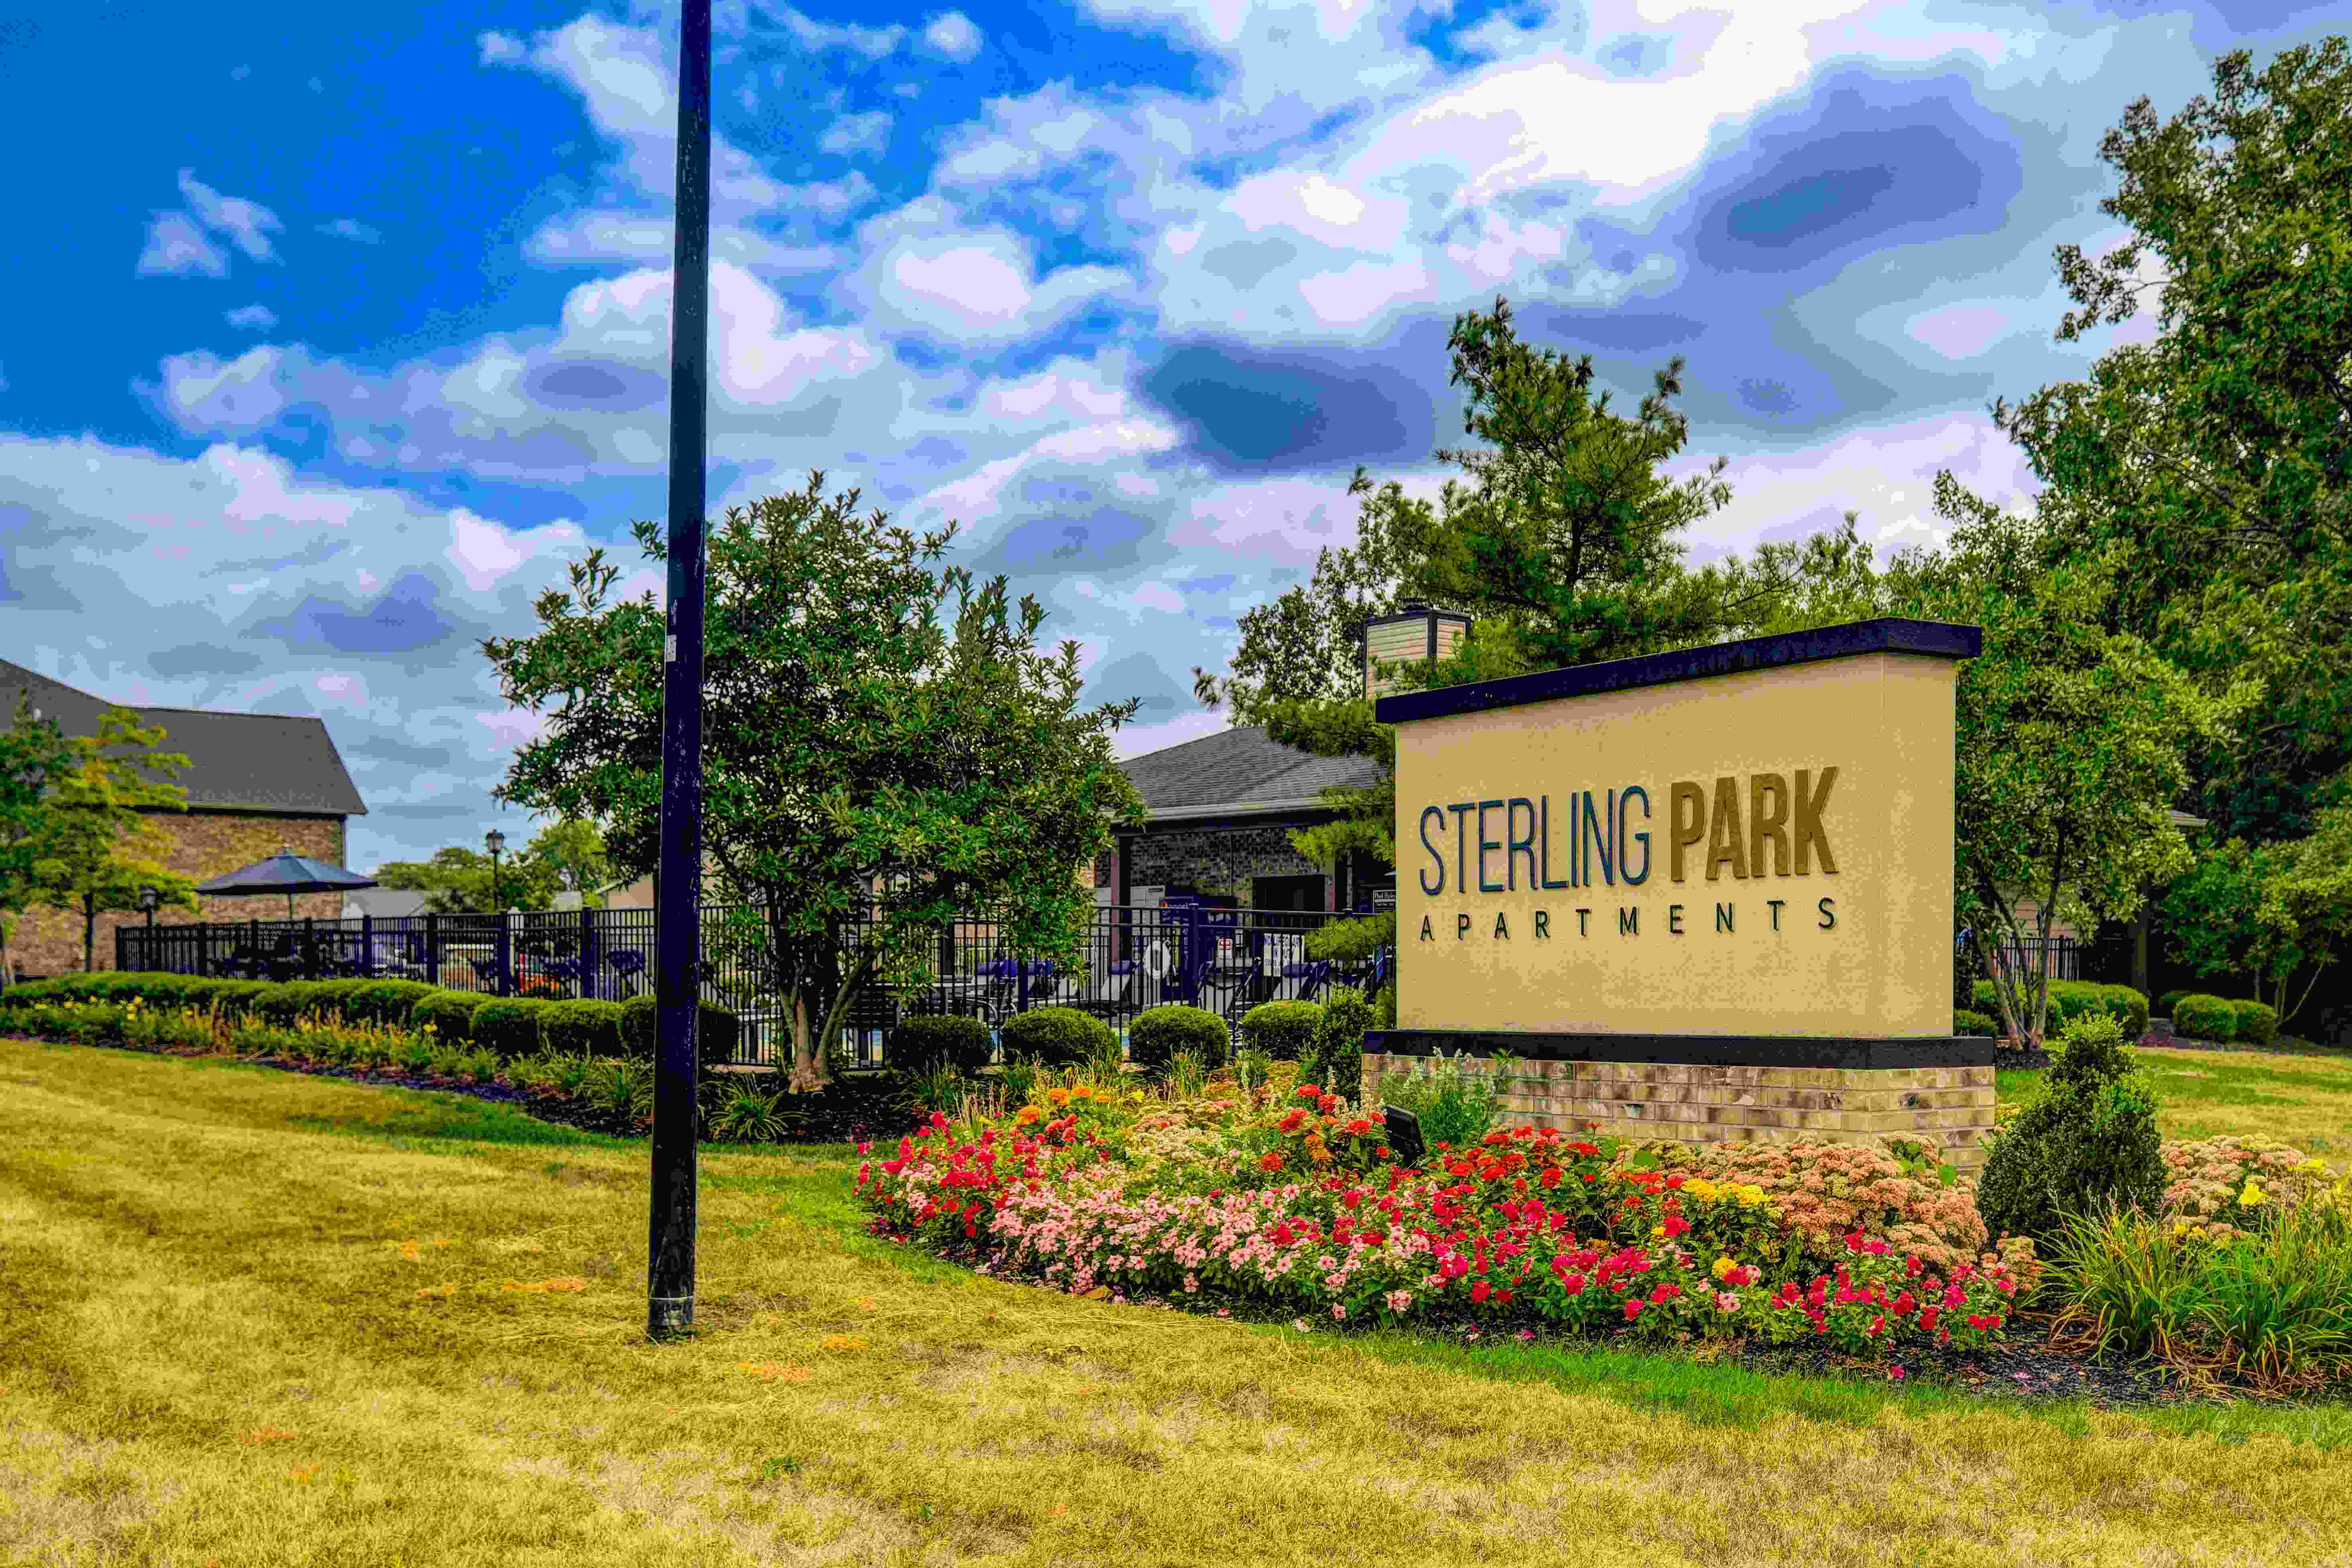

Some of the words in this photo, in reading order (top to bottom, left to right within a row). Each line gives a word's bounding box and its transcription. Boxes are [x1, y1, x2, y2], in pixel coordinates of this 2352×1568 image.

[1419, 785, 1651, 895] STERLING
[1671, 766, 1839, 883] PARK
[1420, 897, 1837, 941] APARTMENTS
